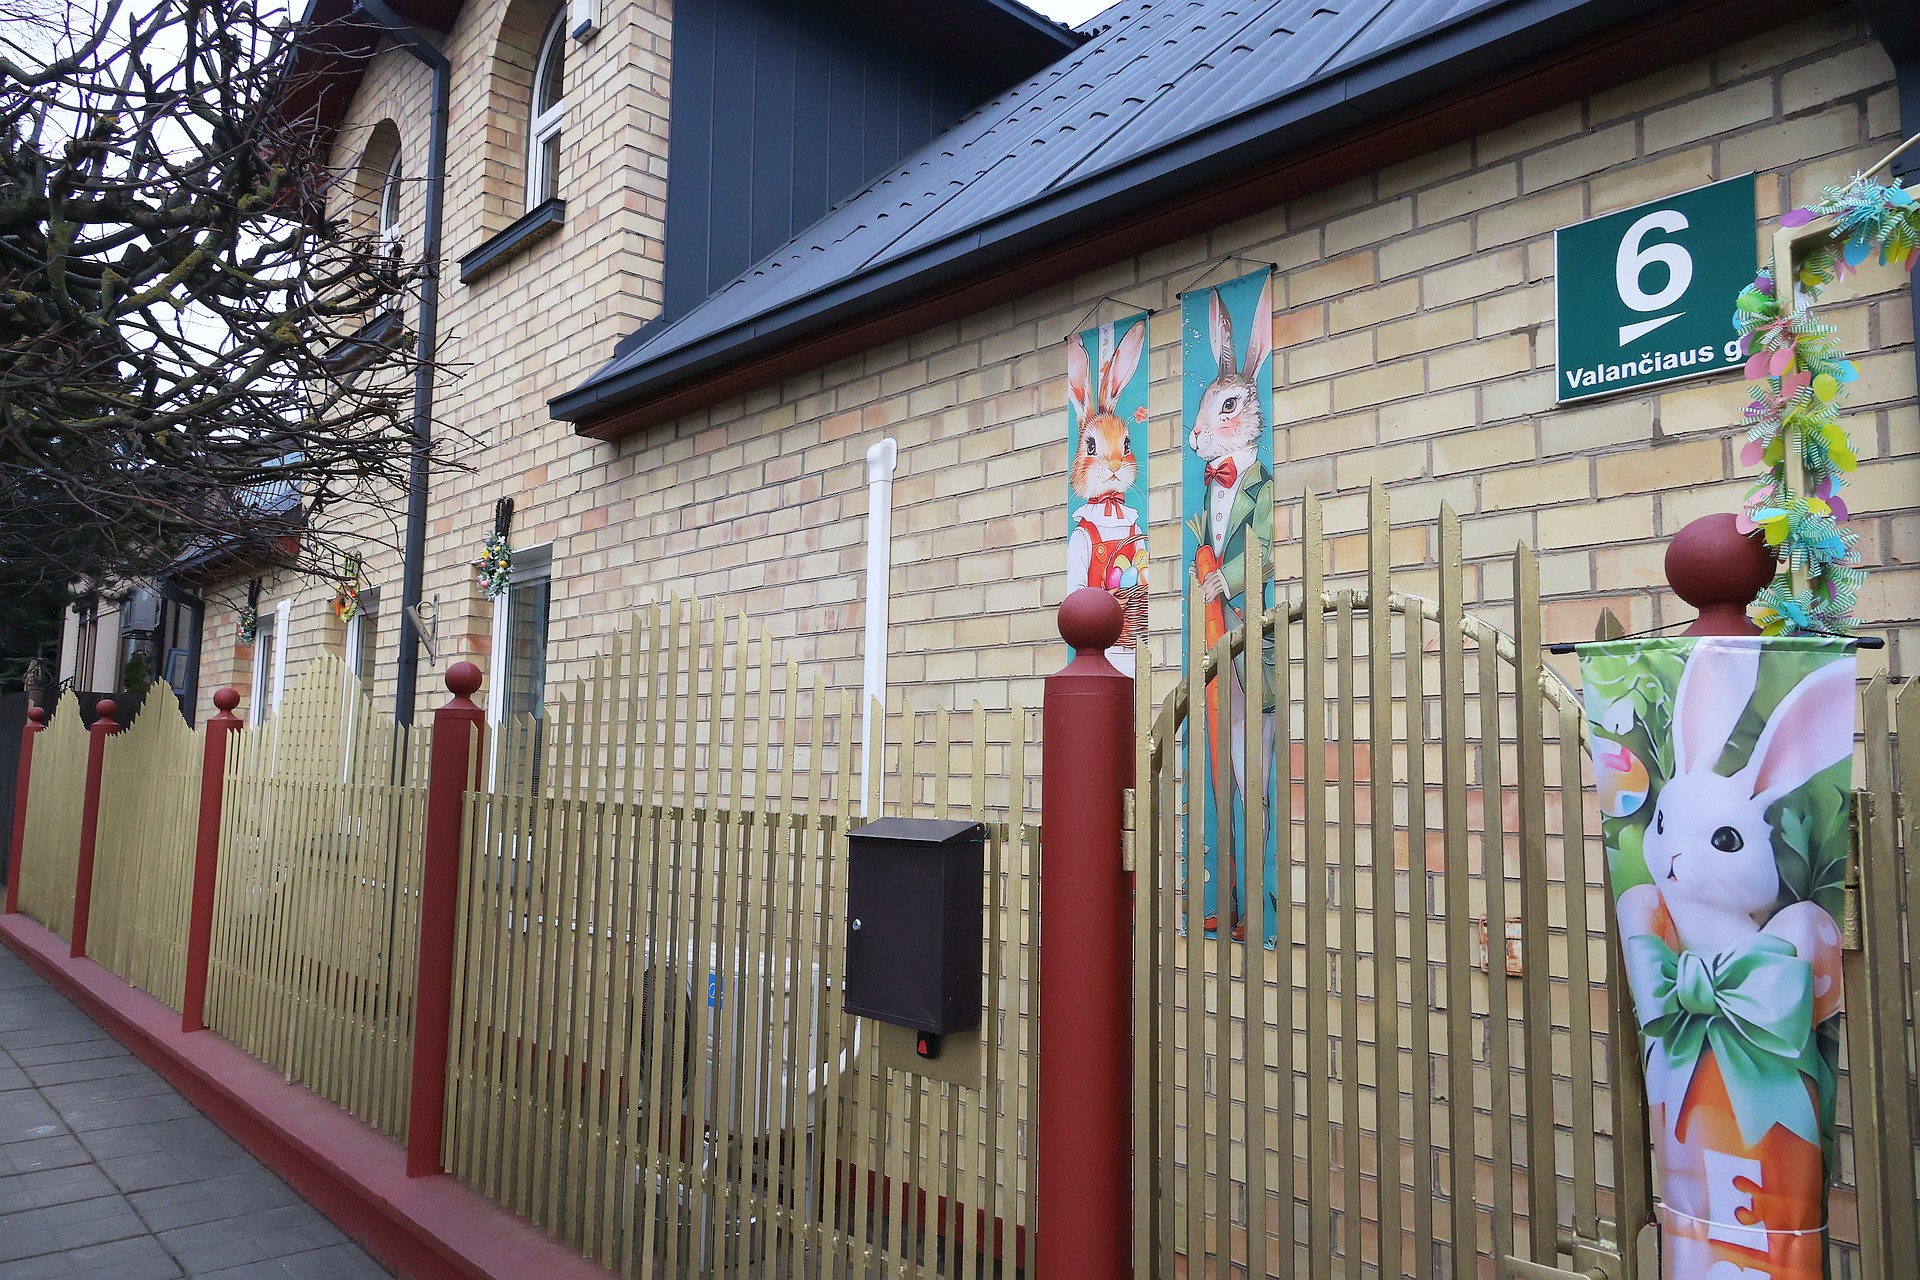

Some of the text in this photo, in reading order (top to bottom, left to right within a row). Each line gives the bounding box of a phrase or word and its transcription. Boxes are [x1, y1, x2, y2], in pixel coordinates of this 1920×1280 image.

[1616, 209, 1693, 312] 6
[1566, 344, 1714, 389] Valančiaus
[1703, 1149, 1771, 1280] E
